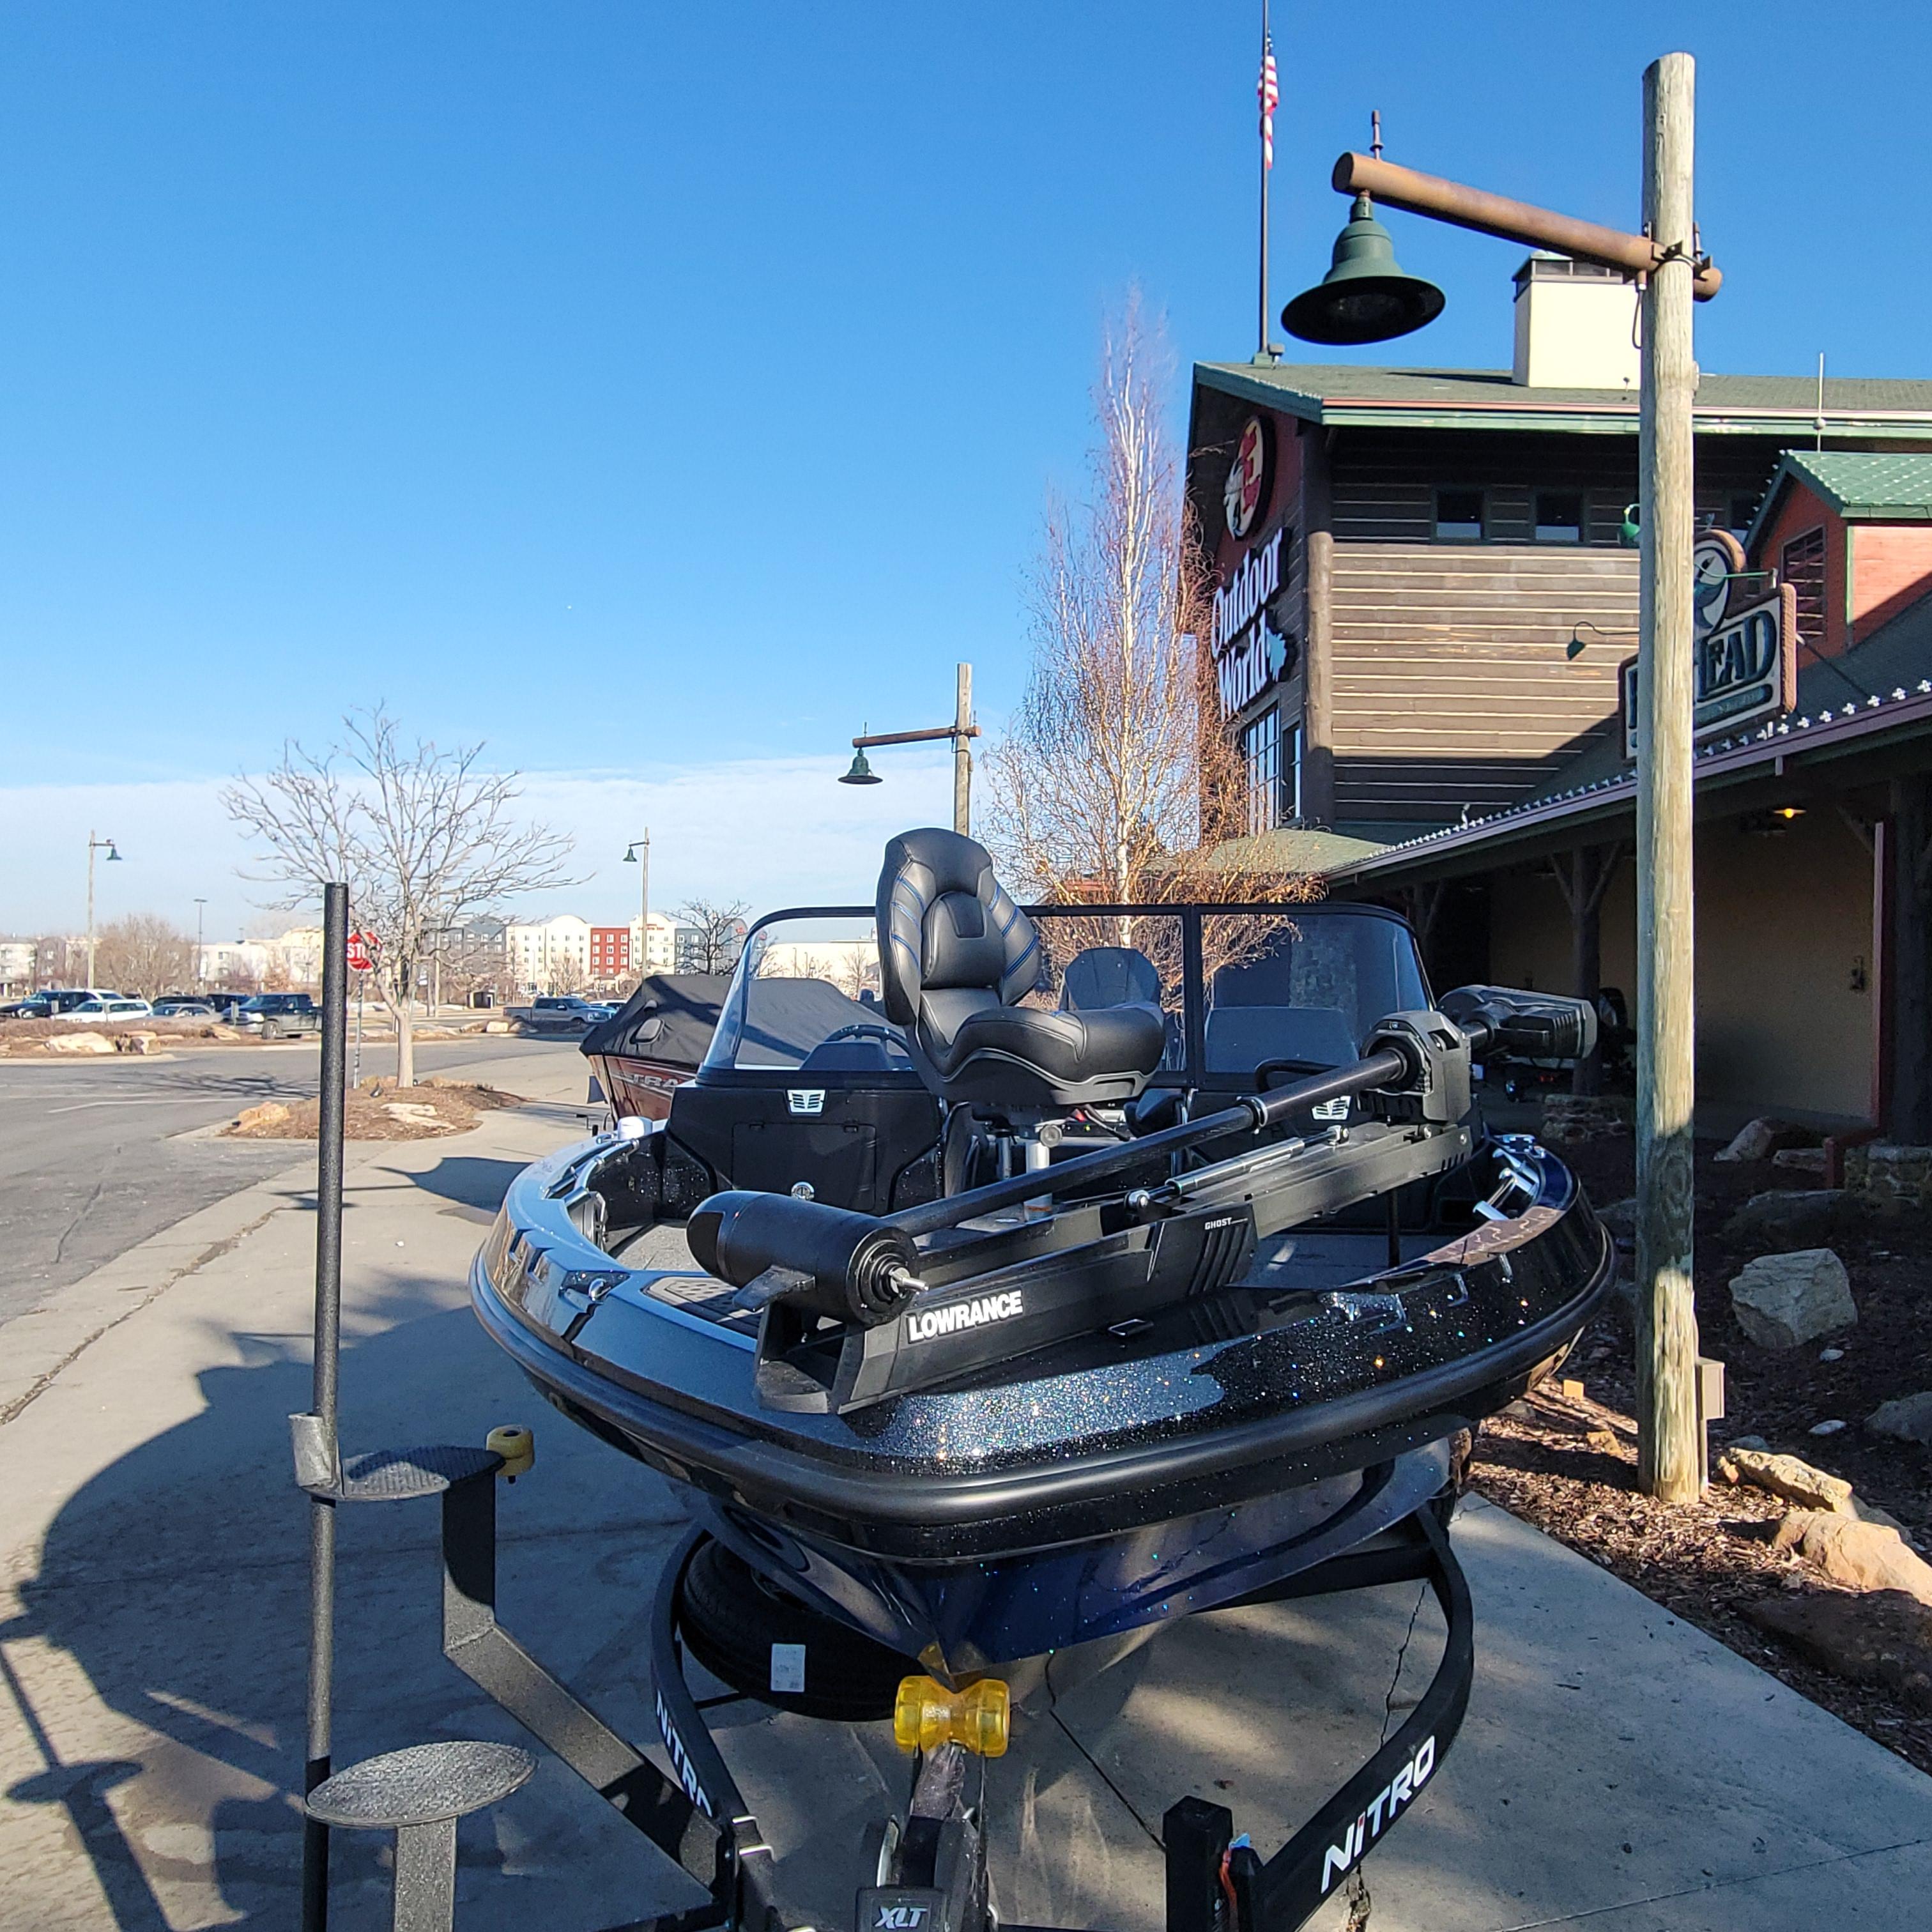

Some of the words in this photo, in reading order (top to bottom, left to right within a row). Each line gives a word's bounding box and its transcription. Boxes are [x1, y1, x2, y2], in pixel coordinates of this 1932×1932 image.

[1211, 528, 1282, 658] Outdoor
[1218, 610, 1267, 723] World
[1205, 1217, 1232, 1230] GHOST
[908, 1290, 1023, 1342] LOWRANCE
[874, 1906, 928, 1929] XLT
